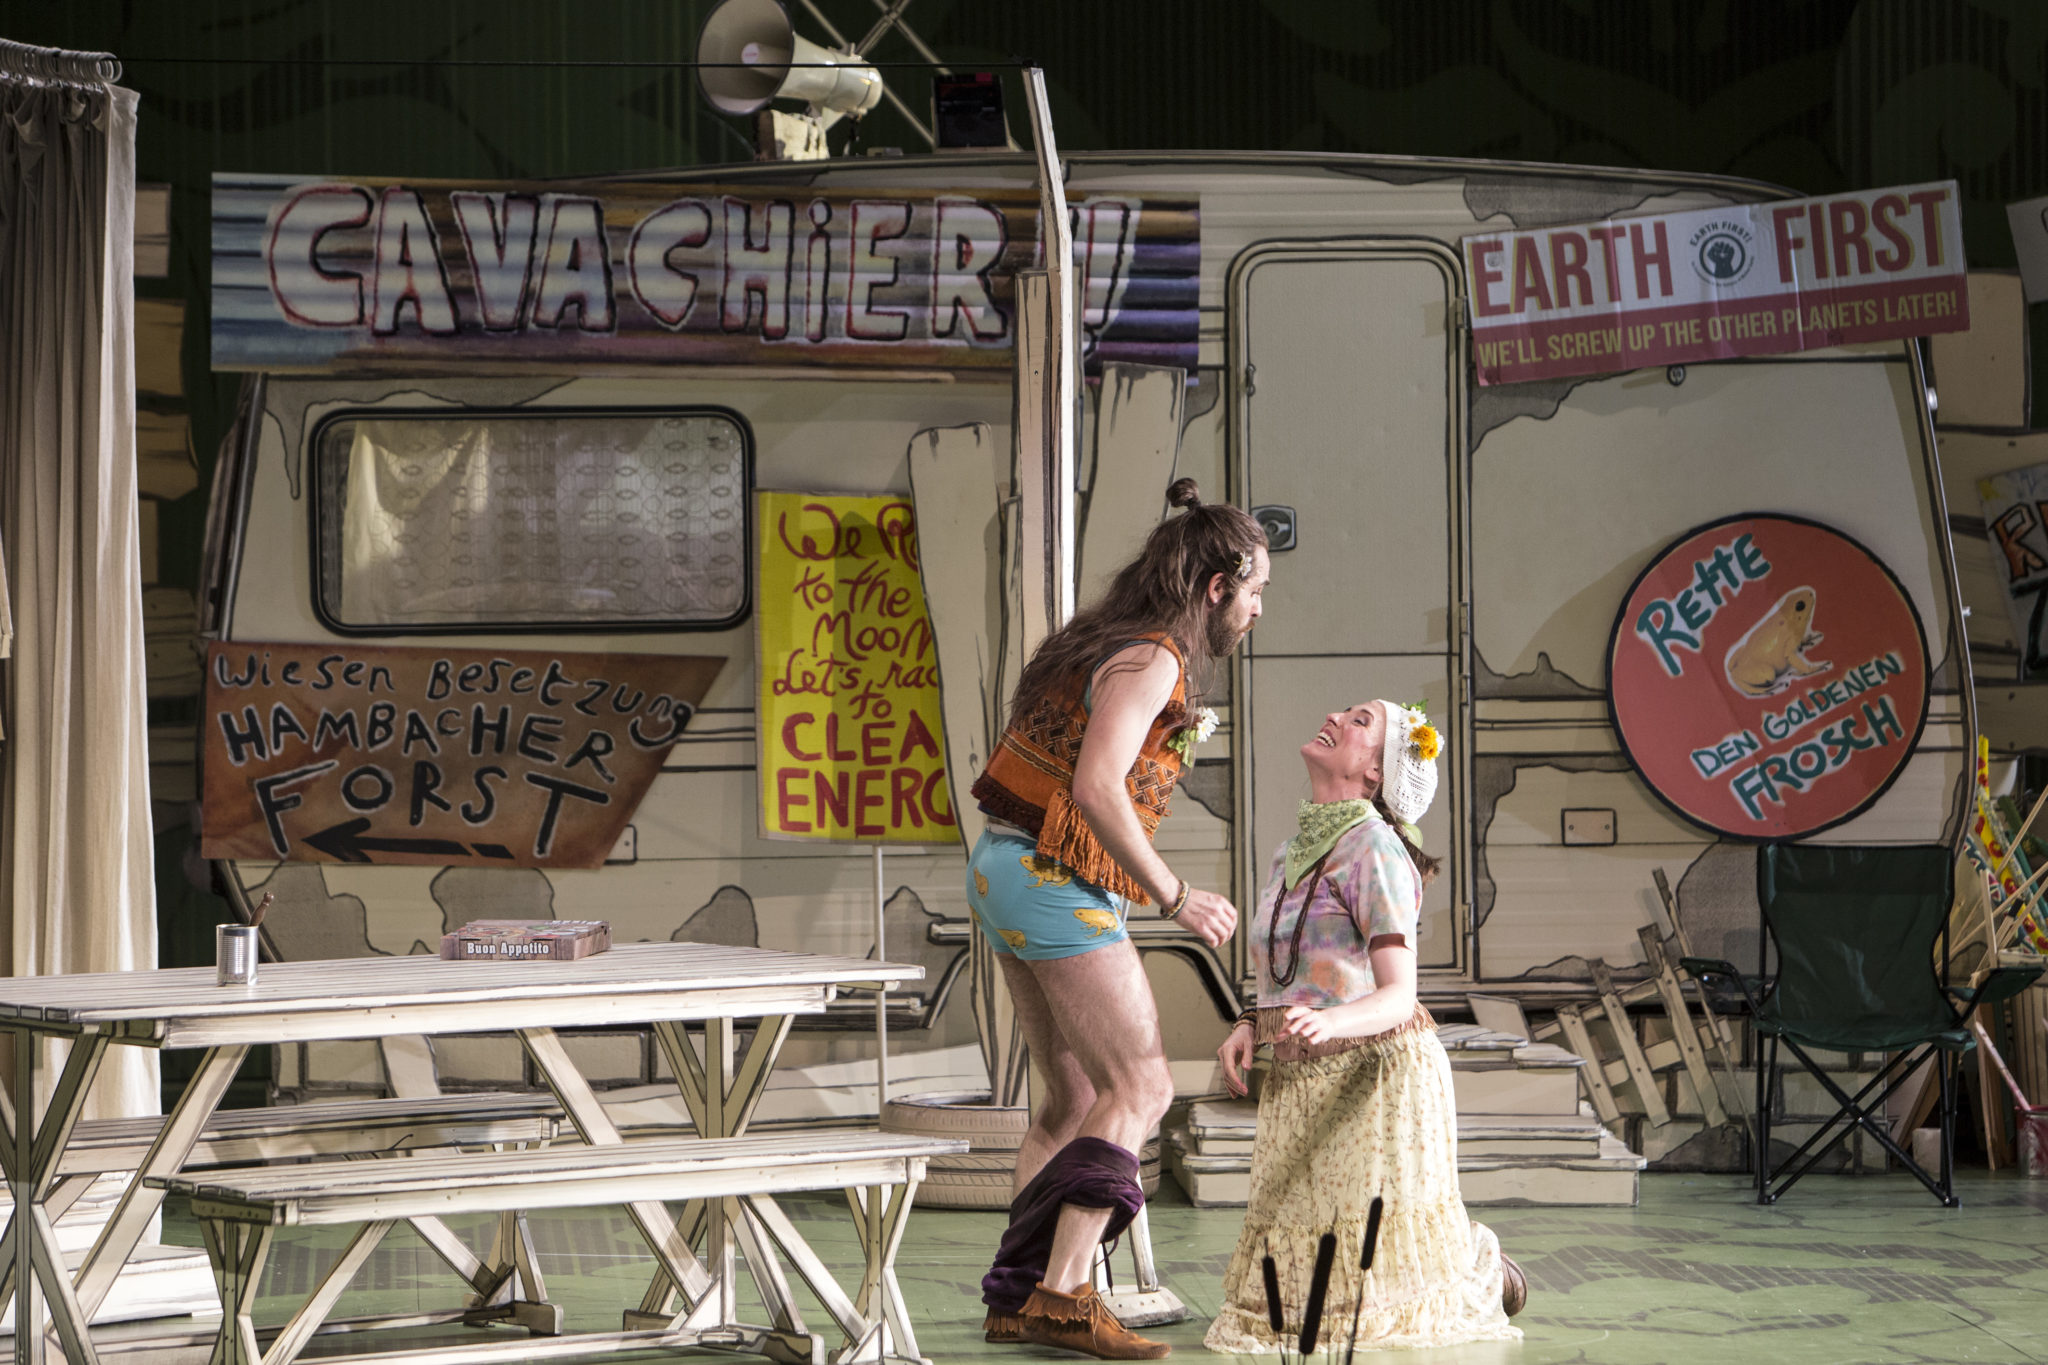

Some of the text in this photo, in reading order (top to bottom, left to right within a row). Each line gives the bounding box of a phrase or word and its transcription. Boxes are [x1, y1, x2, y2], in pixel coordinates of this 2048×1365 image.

[1468, 189, 1953, 318] EARTH FIRST
[1689, 220, 1753, 247] EARTH FIRST!
[1478, 290, 1958, 368] WE'LL SCREW UP THE OTHER PLANETS LATER!
[778, 503, 868, 561] We
[793, 560, 912, 618] to the
[772, 648, 863, 696] Let's
[849, 679, 892, 720] to
[218, 702, 616, 783] HAMBACHER
[782, 709, 940, 766] CLEA
[1691, 652, 1903, 778] DEN GOLDENEN
[1732, 696, 1904, 820] FROSCH
[254, 760, 610, 858] FORST
[777, 768, 957, 838] ENERG
[467, 942, 550, 957] Buon Appetito
